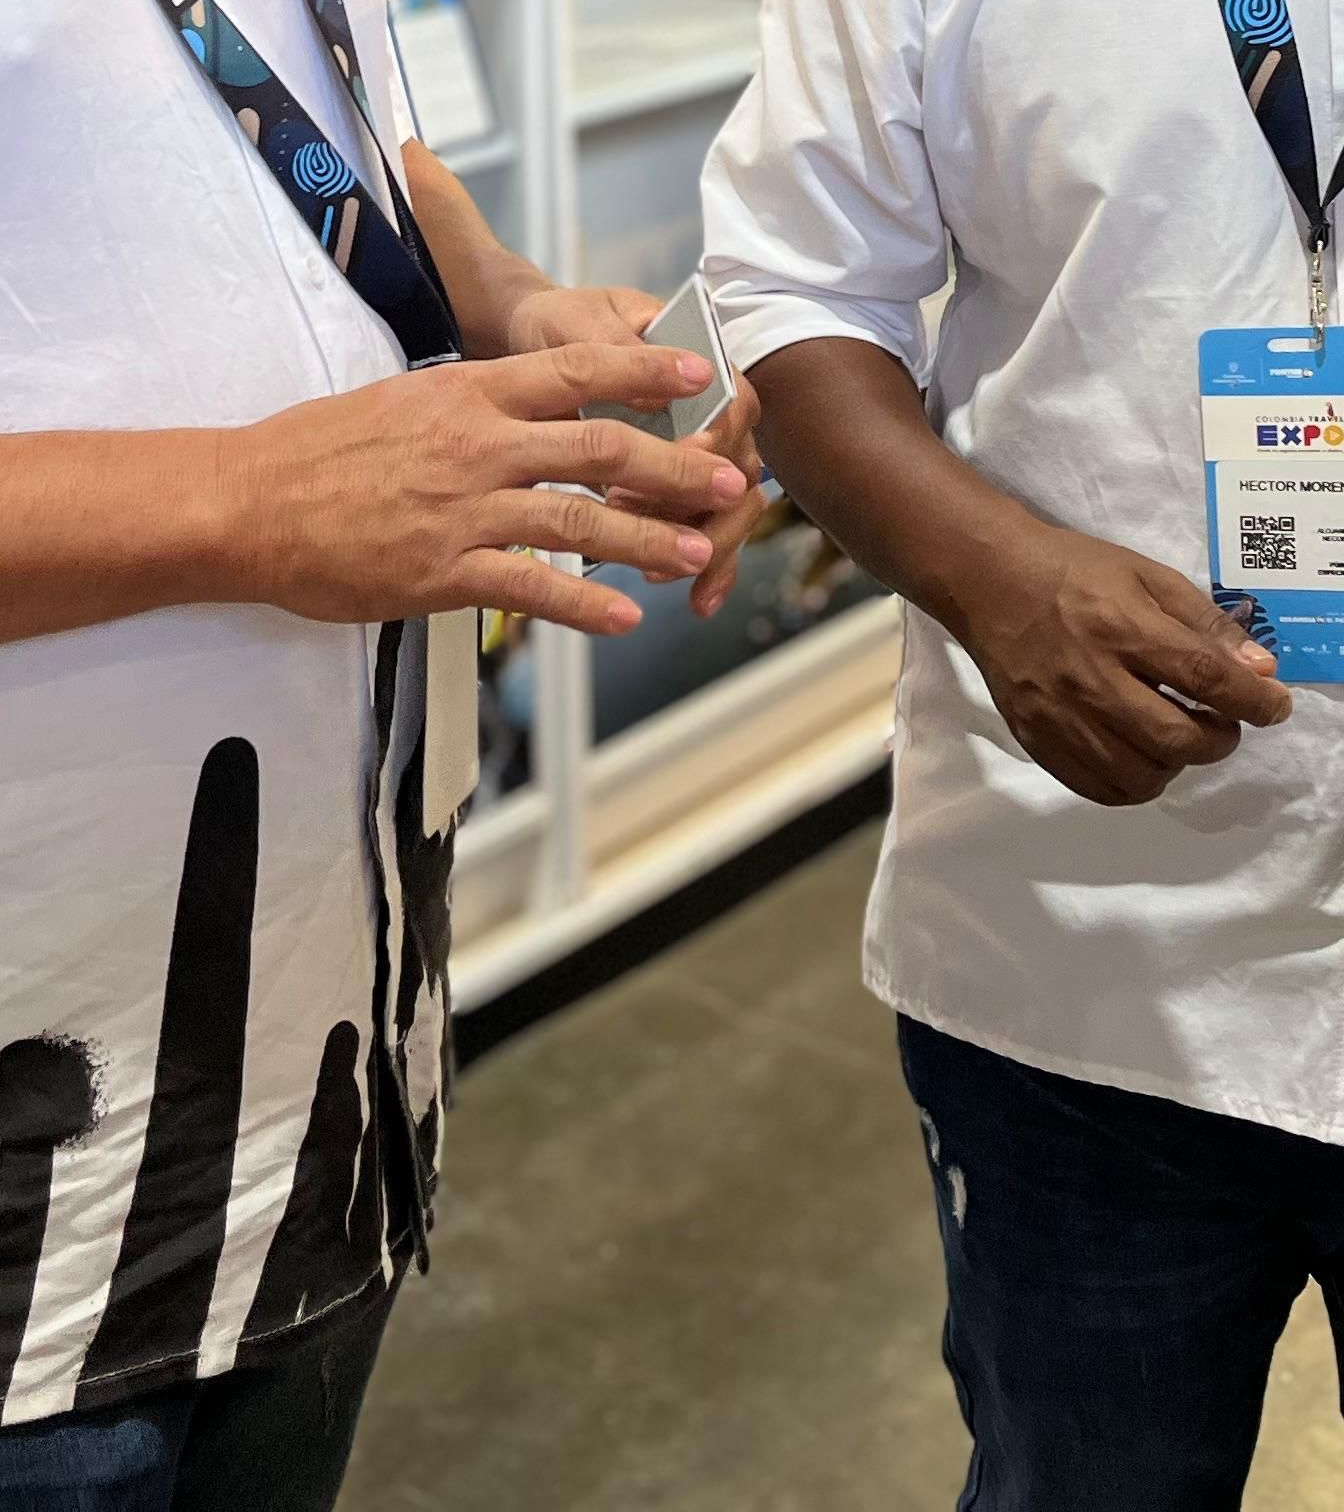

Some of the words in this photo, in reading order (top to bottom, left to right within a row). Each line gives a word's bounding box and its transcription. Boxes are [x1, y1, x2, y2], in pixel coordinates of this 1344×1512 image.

[1308, 415, 1344, 423] TRAVEL
[1256, 425, 1344, 446] EXPO
[1239, 480, 1296, 492] HECTOR
